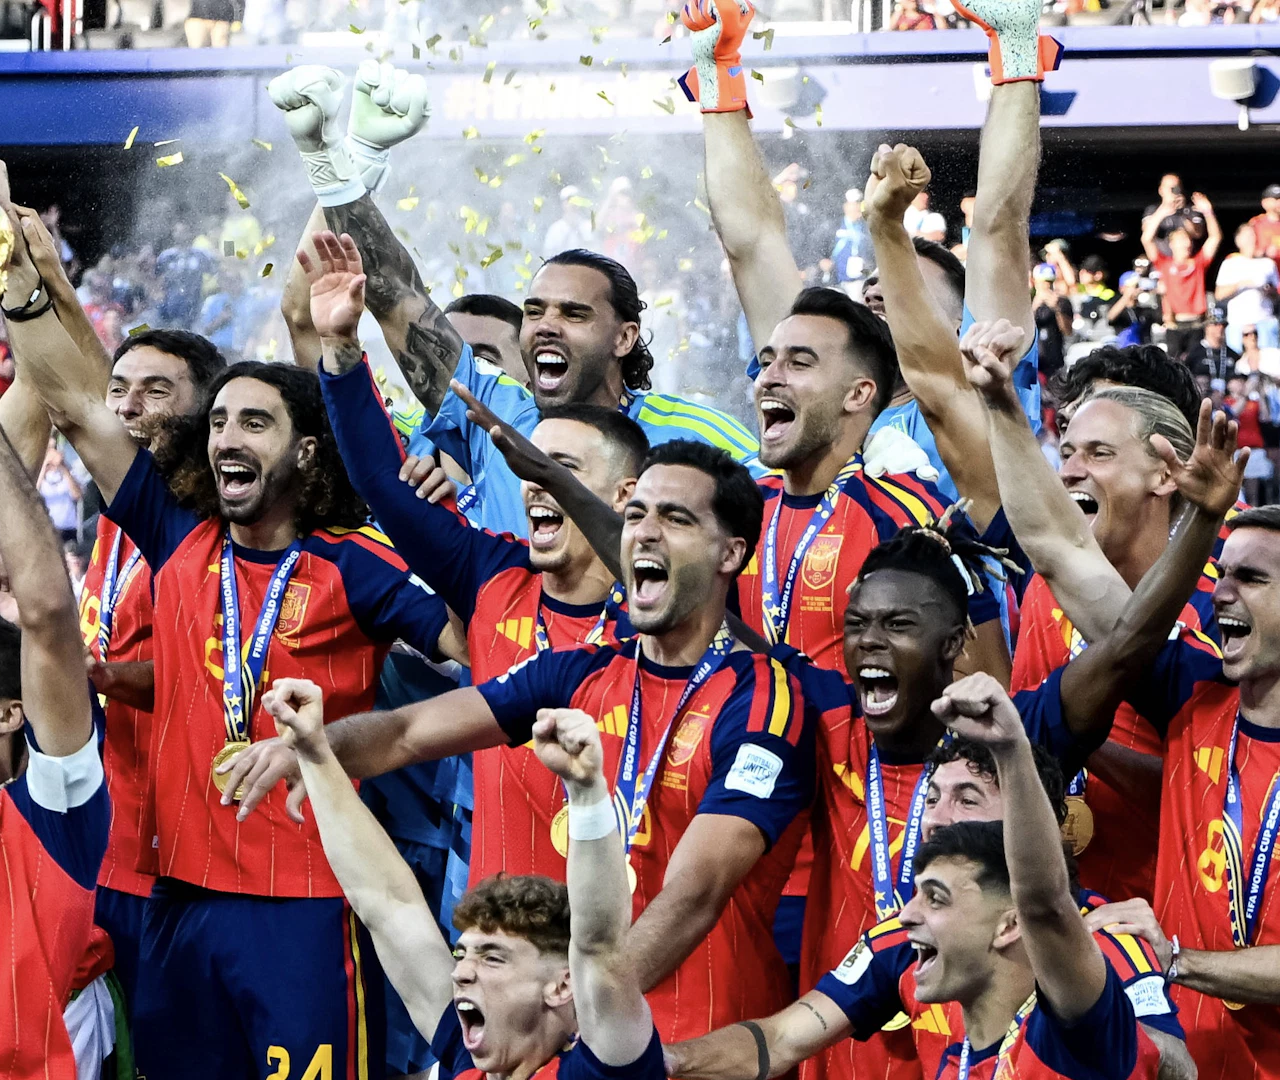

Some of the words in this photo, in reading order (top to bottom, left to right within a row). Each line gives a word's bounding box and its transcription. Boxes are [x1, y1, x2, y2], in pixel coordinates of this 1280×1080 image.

[221, 557, 230, 582] FIFA
[279, 550, 300, 579] 2026
[781, 581, 792, 619] WORLD
[788, 560, 798, 581] CUP
[795, 524, 817, 560] 2026
[222, 582, 234, 617] WORLD
[270, 578, 283, 599] CUP
[225, 618, 235, 640] CUP
[259, 598, 277, 633] WORLD
[226, 641, 236, 673] 2026
[252, 632, 267, 658] FIFA
[692, 661, 711, 685] FIFA
[628, 725, 638, 746] CUP
[623, 746, 636, 782] 2026
[870, 757, 878, 780] FIFA
[869, 780, 882, 818] WORLD
[913, 795, 925, 821] CUP
[873, 819, 883, 841] CUP
[904, 820, 920, 860] WORLD
[874, 842, 888, 882] 2026
[1197, 818, 1228, 892] 8
[901, 860, 912, 884] FIFA
[1245, 893, 1257, 919] FIFA
[1251, 853, 1267, 893] WORLD
[1260, 829, 1273, 852] CUP
